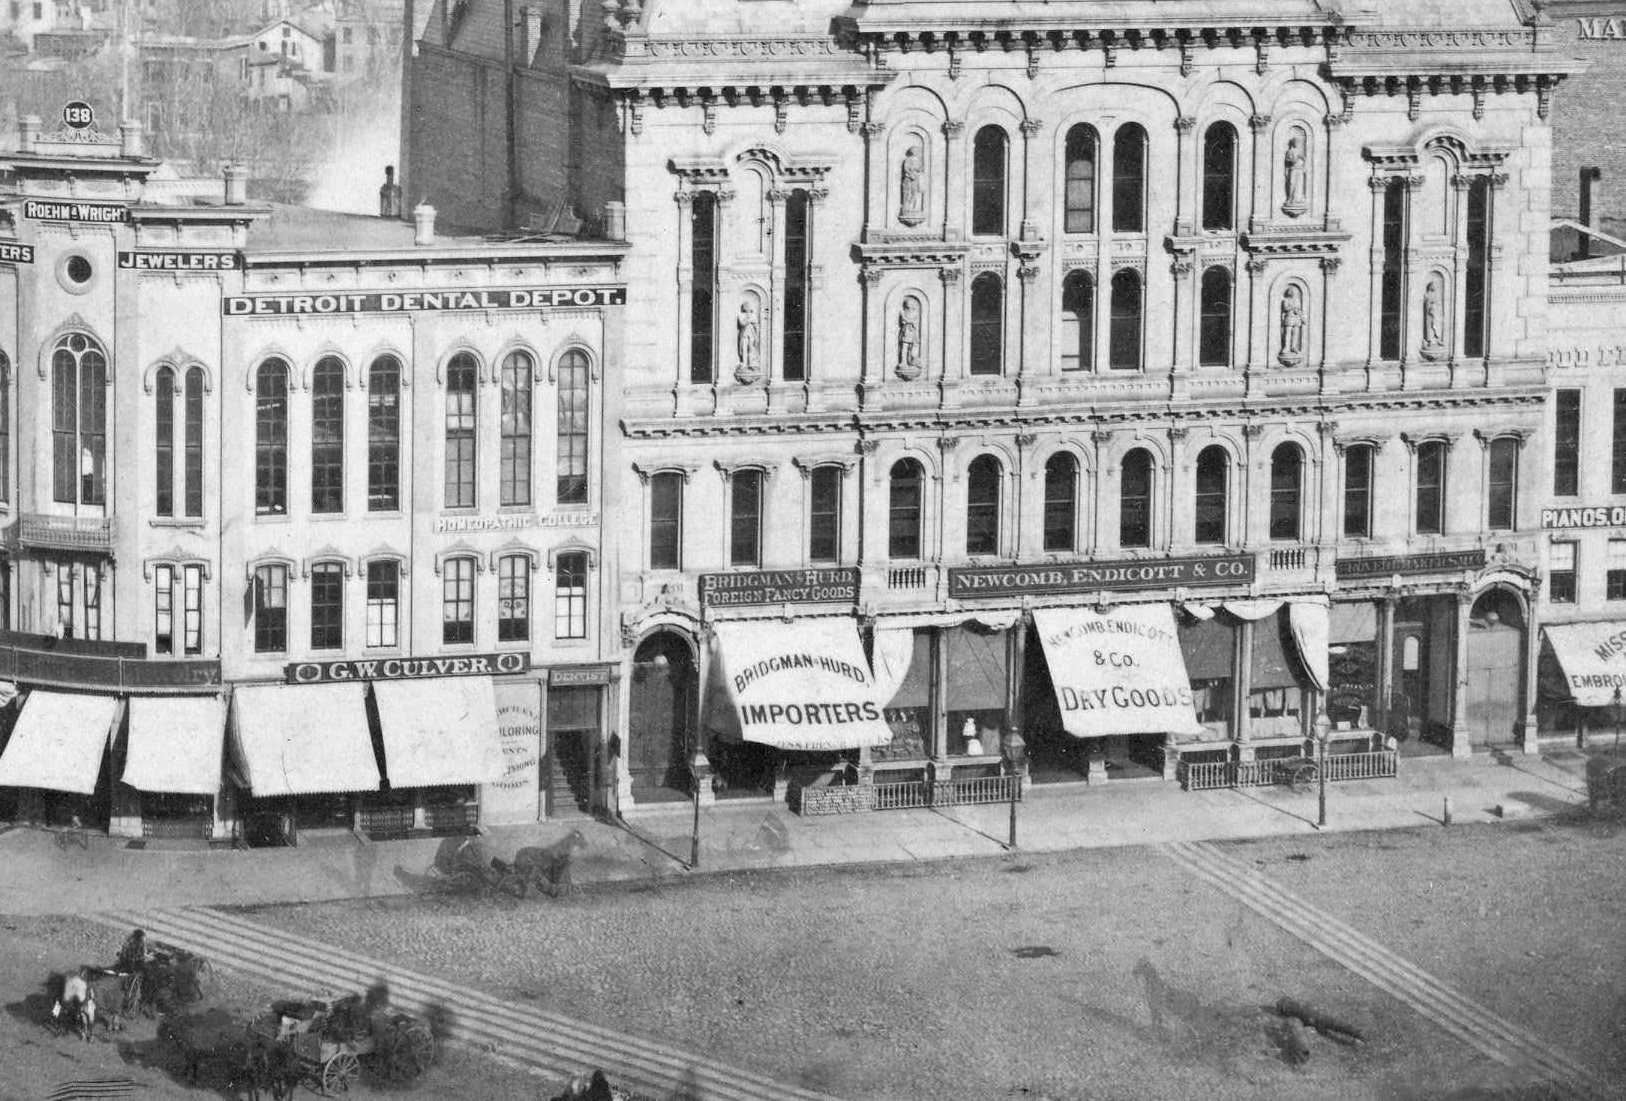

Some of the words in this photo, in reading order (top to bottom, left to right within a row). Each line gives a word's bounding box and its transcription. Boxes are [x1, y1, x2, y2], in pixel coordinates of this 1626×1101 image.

[65, 108, 90, 123] 138
[27, 201, 70, 220] ROEHM
[121, 253, 234, 269] JEWELERS
[230, 295, 367, 314] DETROIT
[381, 291, 500, 310] DENTAL
[509, 288, 623, 307] DEPOT.
[438, 516, 533, 532] HOMEOPATHIC
[540, 514, 600, 527] COLLEGE
[704, 573, 794, 590] BRIDGMAN
[957, 571, 1068, 589] NEWCOMB,
[1072, 565, 1184, 583] ENDICOTT
[1192, 562, 1206, 576] &
[1215, 562, 1249, 576] CO.
[703, 590, 763, 606] FOREIGN
[765, 587, 810, 603] FANCY
[812, 586, 854, 600] GOODS
[384, 657, 492, 676] CULVER.
[1094, 649, 1106, 666] &
[553, 670, 609, 683] DENTIST
[734, 653, 814, 694] BRIDGMAN
[1062, 687, 1107, 711] DRY
[1112, 686, 1192, 708] GOODS
[741, 701, 880, 725] IMPORTERS
